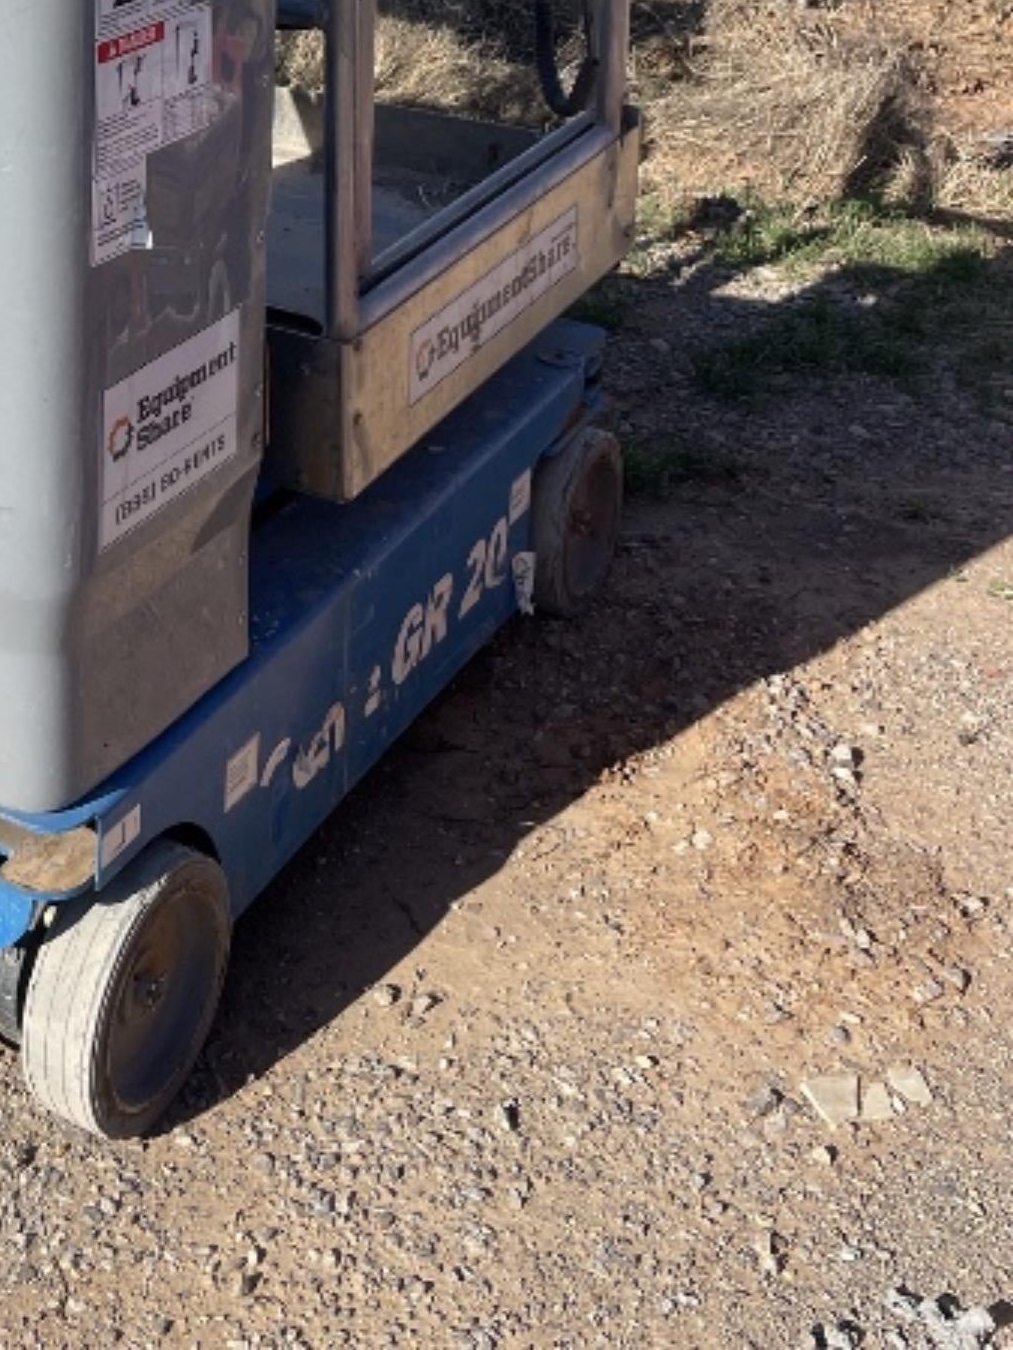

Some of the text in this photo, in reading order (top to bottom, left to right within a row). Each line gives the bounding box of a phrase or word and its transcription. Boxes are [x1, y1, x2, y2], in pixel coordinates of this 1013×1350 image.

[435, 232, 572, 361] EquipmentShare
[135, 402, 193, 452] Share
[136, 341, 237, 423] Equipment
[391, 572, 454, 685] GR
[458, 515, 510, 620] 20
